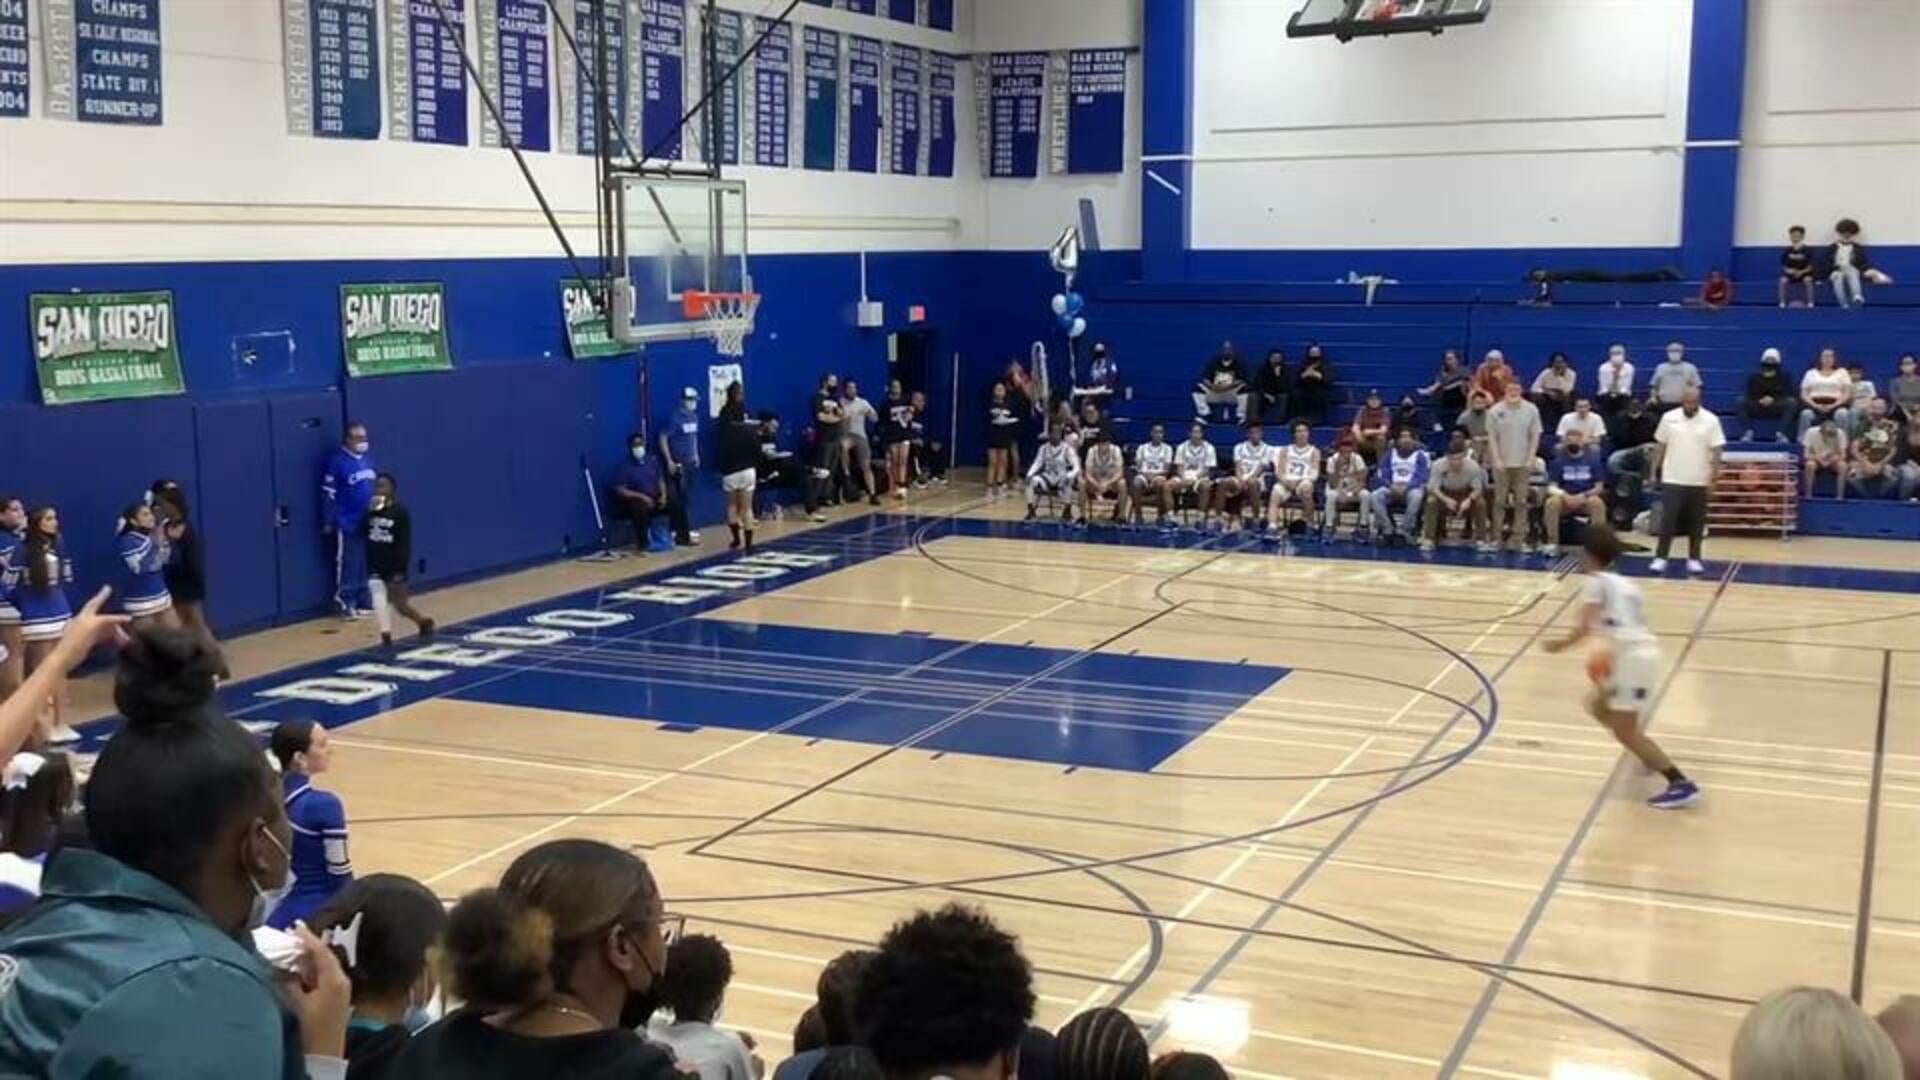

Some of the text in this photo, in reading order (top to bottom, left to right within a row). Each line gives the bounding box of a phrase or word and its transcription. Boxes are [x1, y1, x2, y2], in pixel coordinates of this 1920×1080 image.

[92, 0, 147, 19] CHAMPS
[92, 49, 149, 69] CHAMPS
[81, 74, 122, 91] STATE
[346, 293, 440, 338] SAN DIEGO
[38, 303, 168, 359] SAN DIEGO
[88, 363, 163, 384] BASKETBALL
[253, 550, 839, 704] DIEGO HIGH
